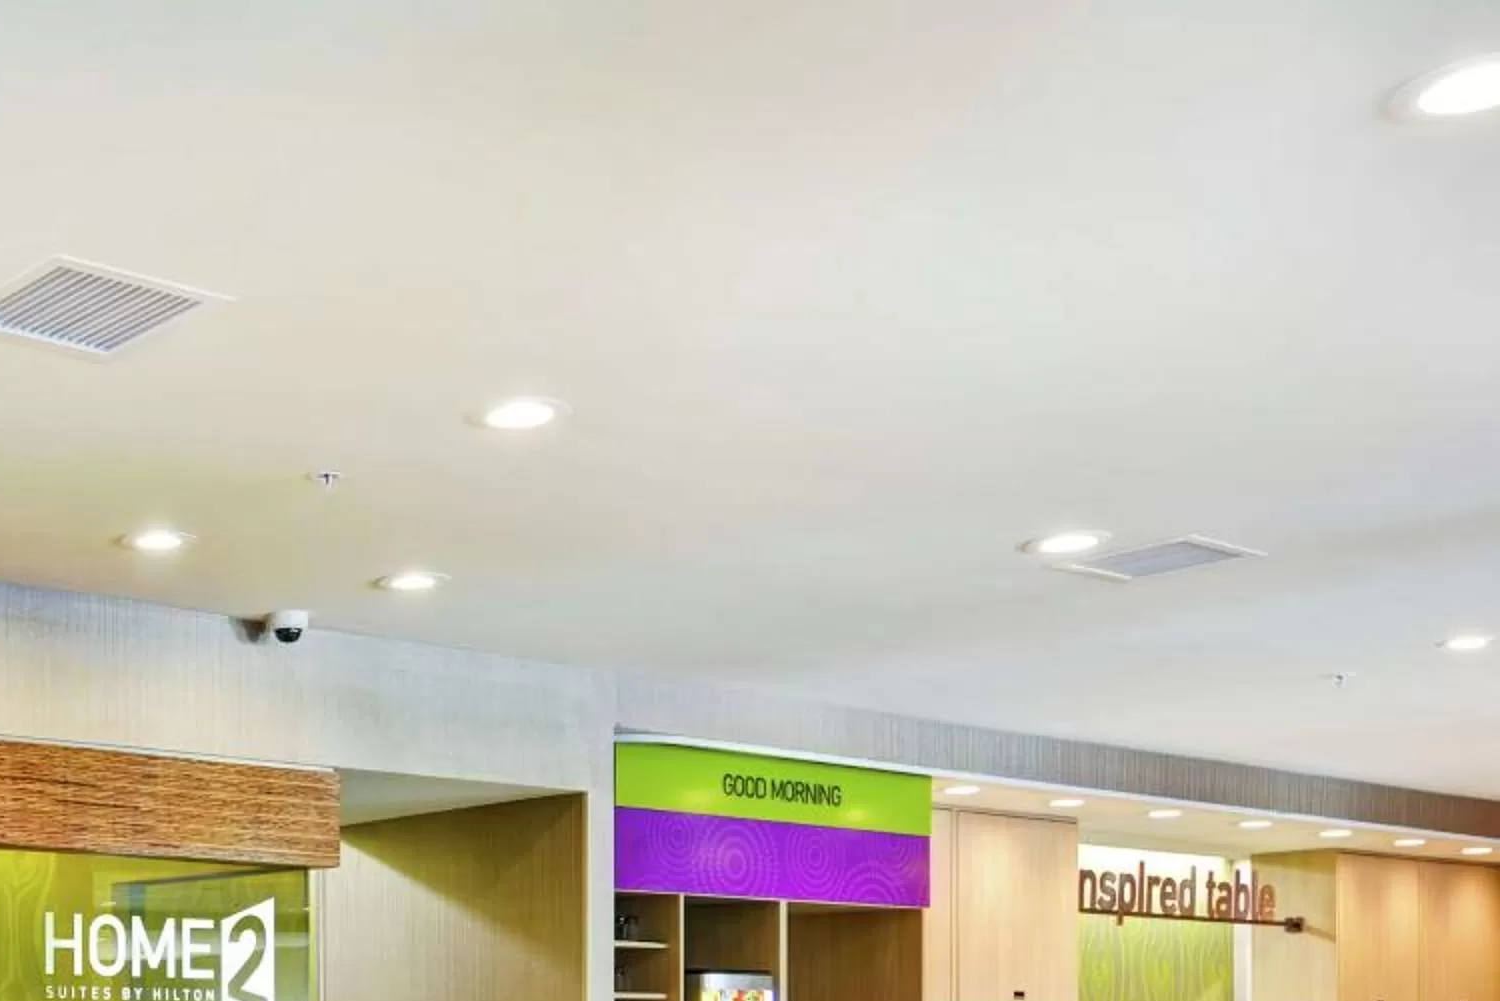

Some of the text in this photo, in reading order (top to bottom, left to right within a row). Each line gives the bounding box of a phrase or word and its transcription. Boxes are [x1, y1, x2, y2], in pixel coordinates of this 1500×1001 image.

[723, 773, 841, 807] GOOD MORNING
[1078, 860, 1276, 926] nspired table
[45, 985, 215, 1001] SUITES BY HILTON
